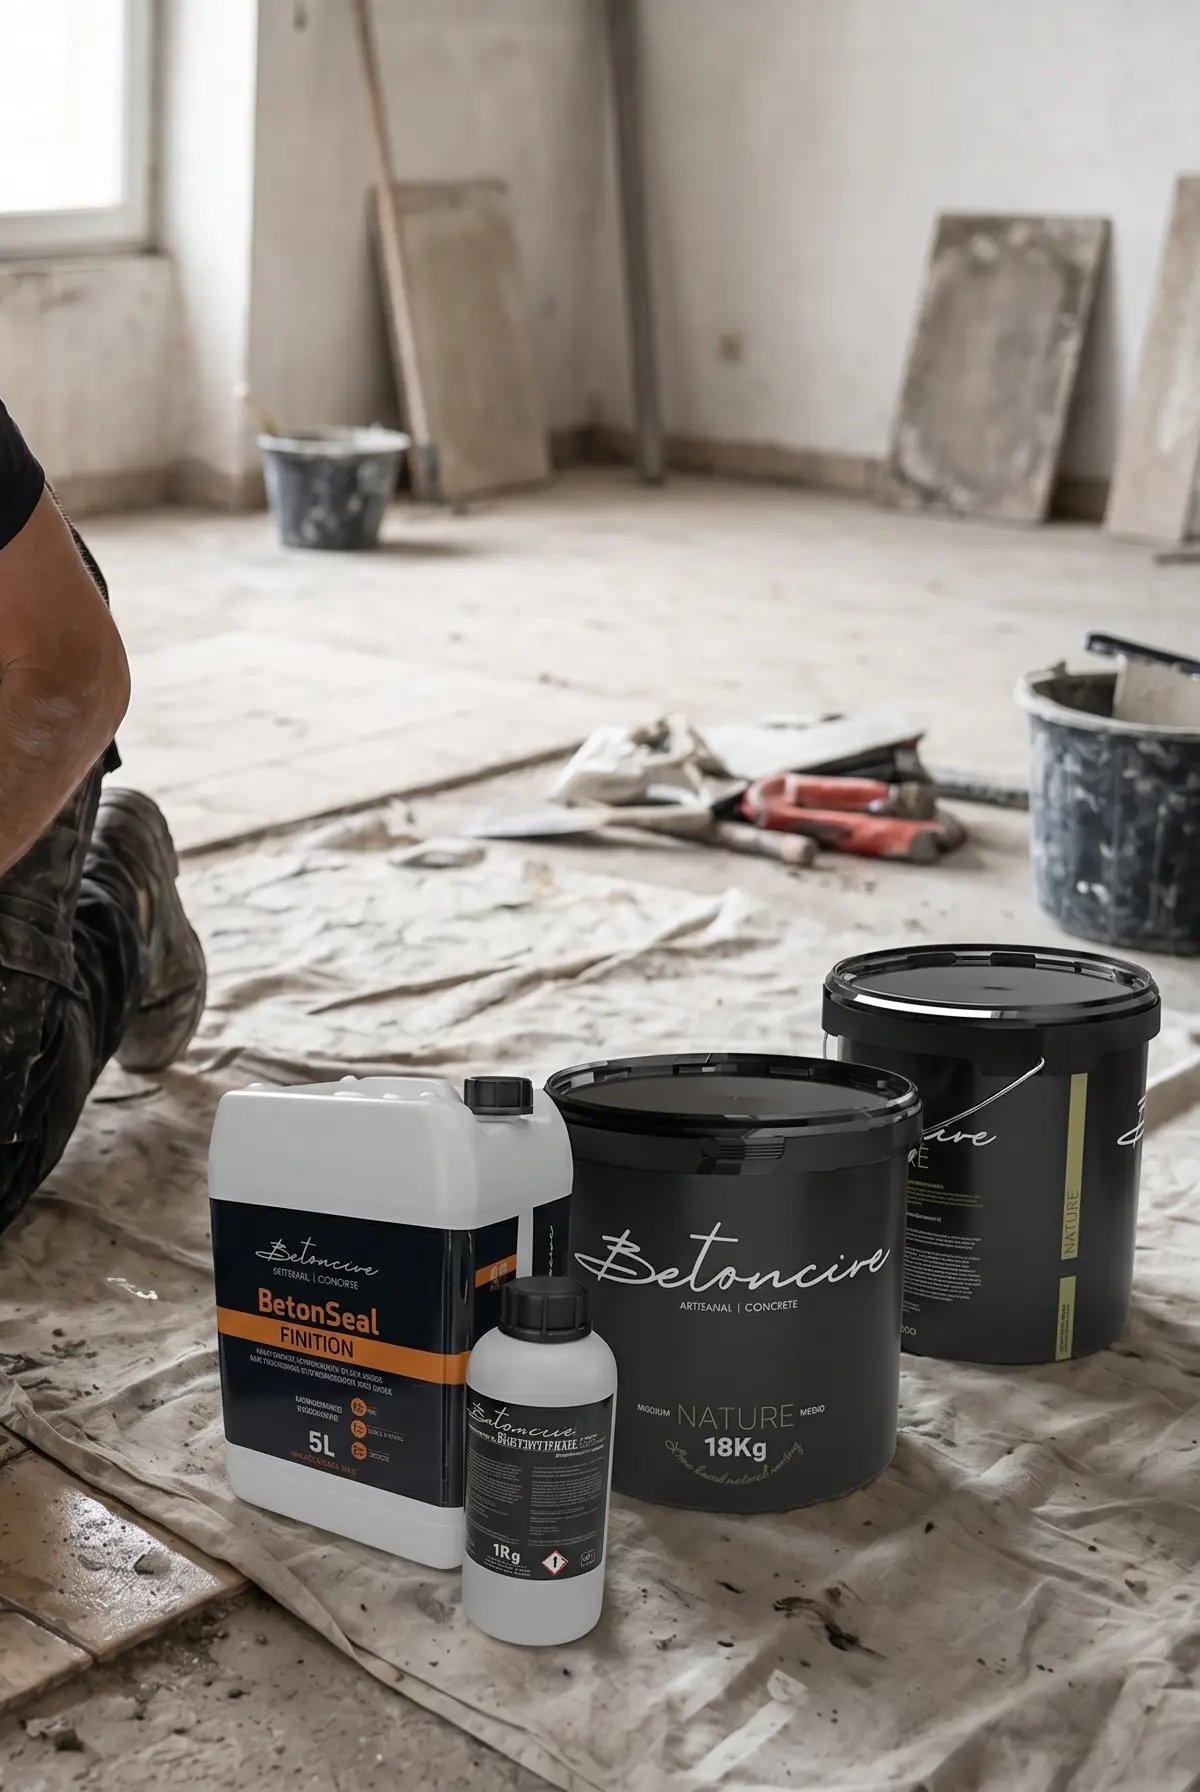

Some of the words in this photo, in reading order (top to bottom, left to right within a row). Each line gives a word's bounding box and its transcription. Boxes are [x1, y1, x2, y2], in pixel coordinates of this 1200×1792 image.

[1064, 1189, 1079, 1254] NATURE
[258, 1287, 380, 1336] BetonSeal
[744, 1300, 798, 1313] CONCRETE
[280, 1326, 354, 1358] FINITION
[678, 1403, 794, 1430] NATURE
[309, 1430, 335, 1457] 5L
[704, 1437, 767, 1462] 18Kg
